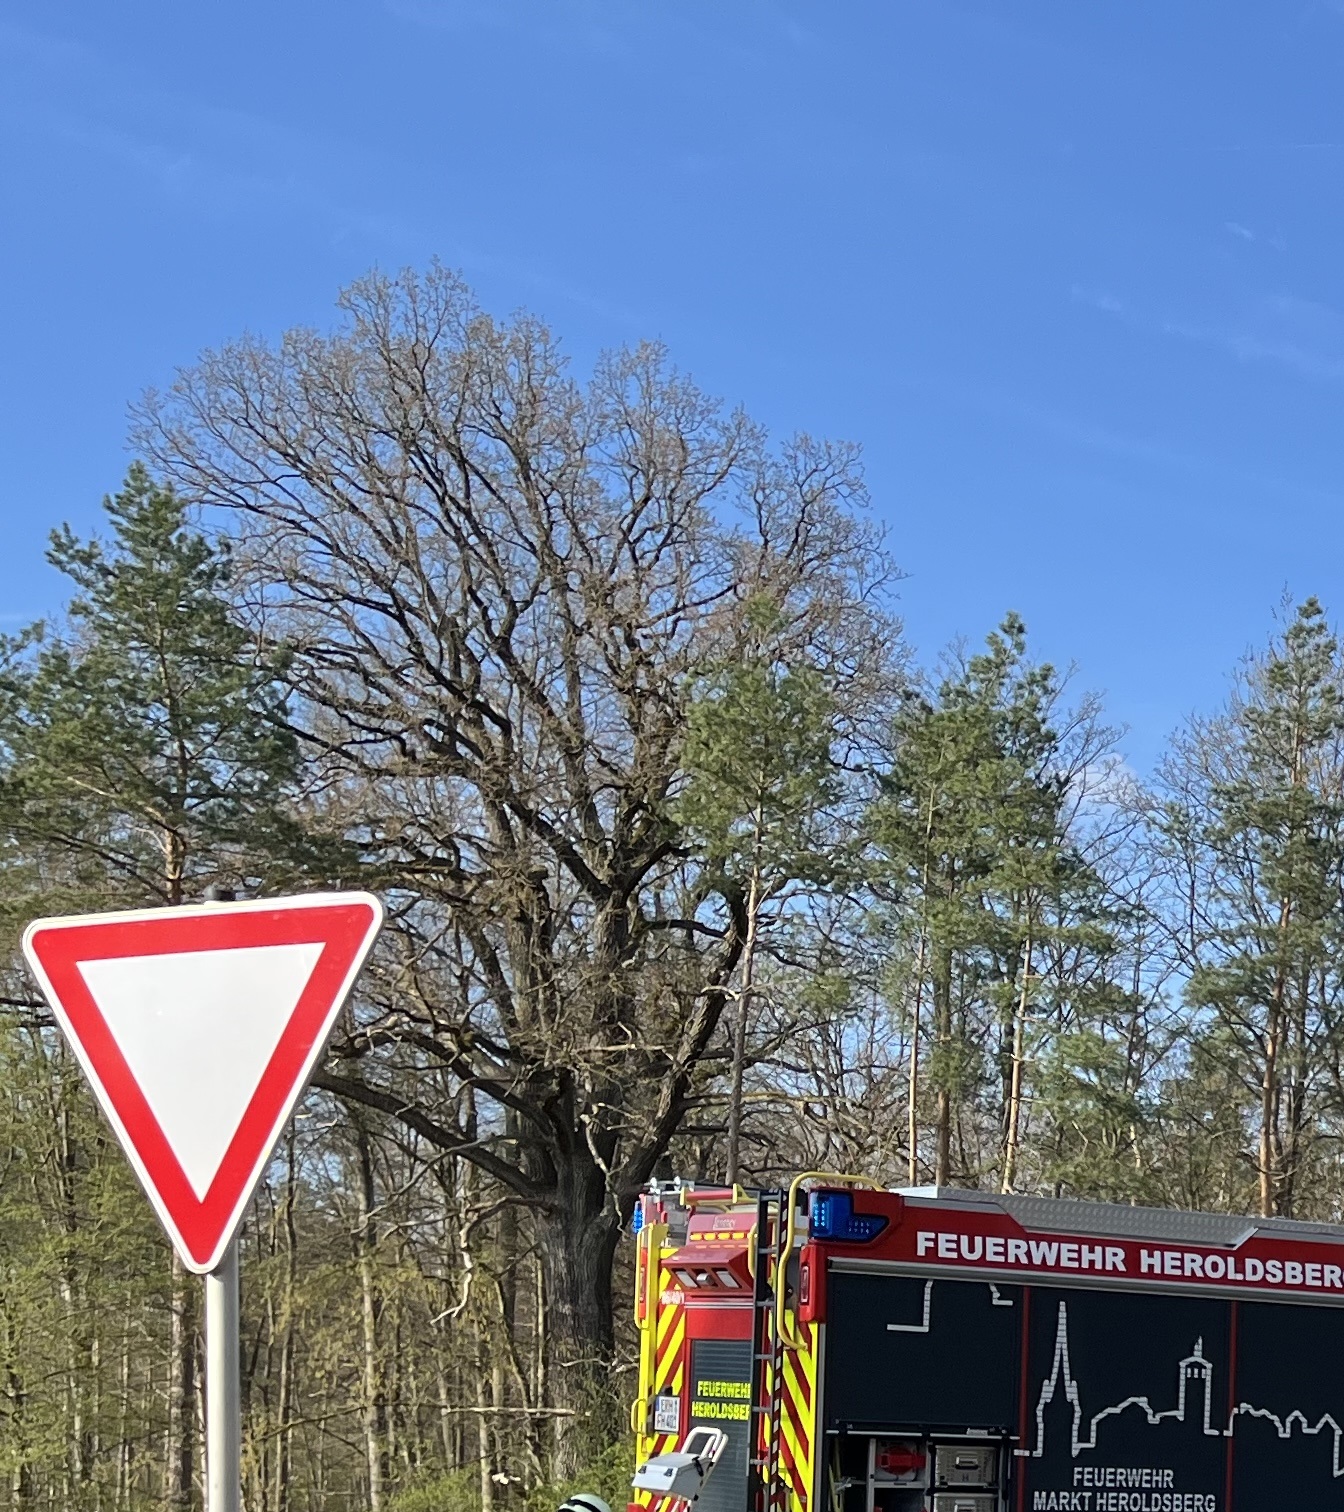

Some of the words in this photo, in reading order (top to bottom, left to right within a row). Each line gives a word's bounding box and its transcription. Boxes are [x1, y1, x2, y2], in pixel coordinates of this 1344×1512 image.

[917, 1231, 1126, 1272] FEUERWEHR
[697, 1380, 751, 1399] FEUERWEH
[1073, 1467, 1174, 1488] FEUERWEHR
[1033, 1491, 1092, 1511] MARKT
[1096, 1492, 1216, 1512] HEROLDSBERG
